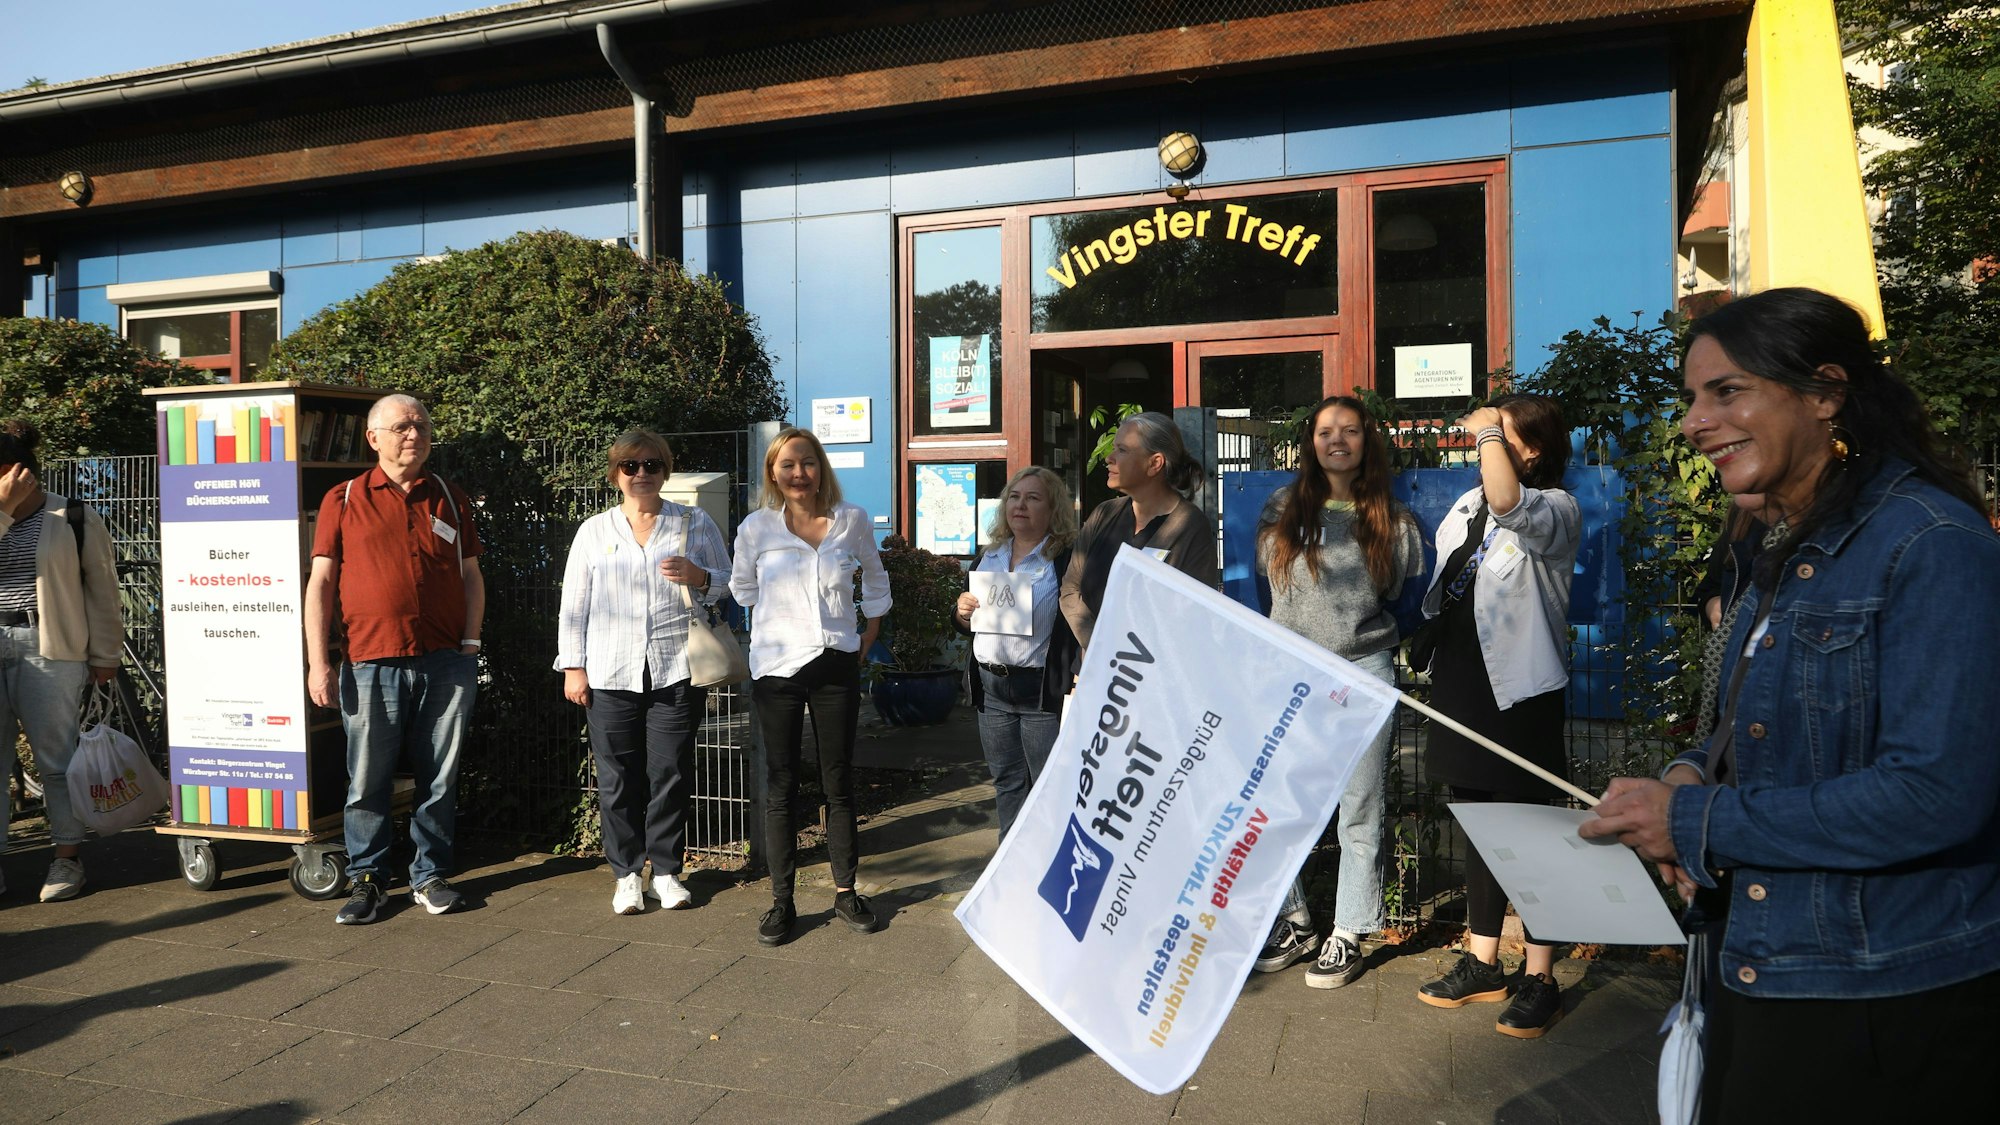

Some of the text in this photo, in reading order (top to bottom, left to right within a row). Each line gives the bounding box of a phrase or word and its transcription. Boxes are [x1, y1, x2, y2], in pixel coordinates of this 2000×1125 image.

[1046, 203, 1321, 289] Vingster Treff
[942, 347, 978, 361] KÖLN
[934, 364, 987, 378] BLEIB(T)
[936, 381, 985, 395] SOZIAL!
[194, 479, 261, 490] OFFENER HöVi
[186, 494, 270, 506] BÜCHERSCHRANK
[209, 549, 250, 560] Bücher
[190, 574, 272, 586] kostenlos
[171, 602, 294, 614] ausleihen, einstellen,
[204, 628, 260, 638] tauschen.
[221, 712, 242, 721] Vingster
[189, 757, 286, 769] Kontakt: Bürgerzentrum Vingst
[182, 768, 219, 777] Würzburger
